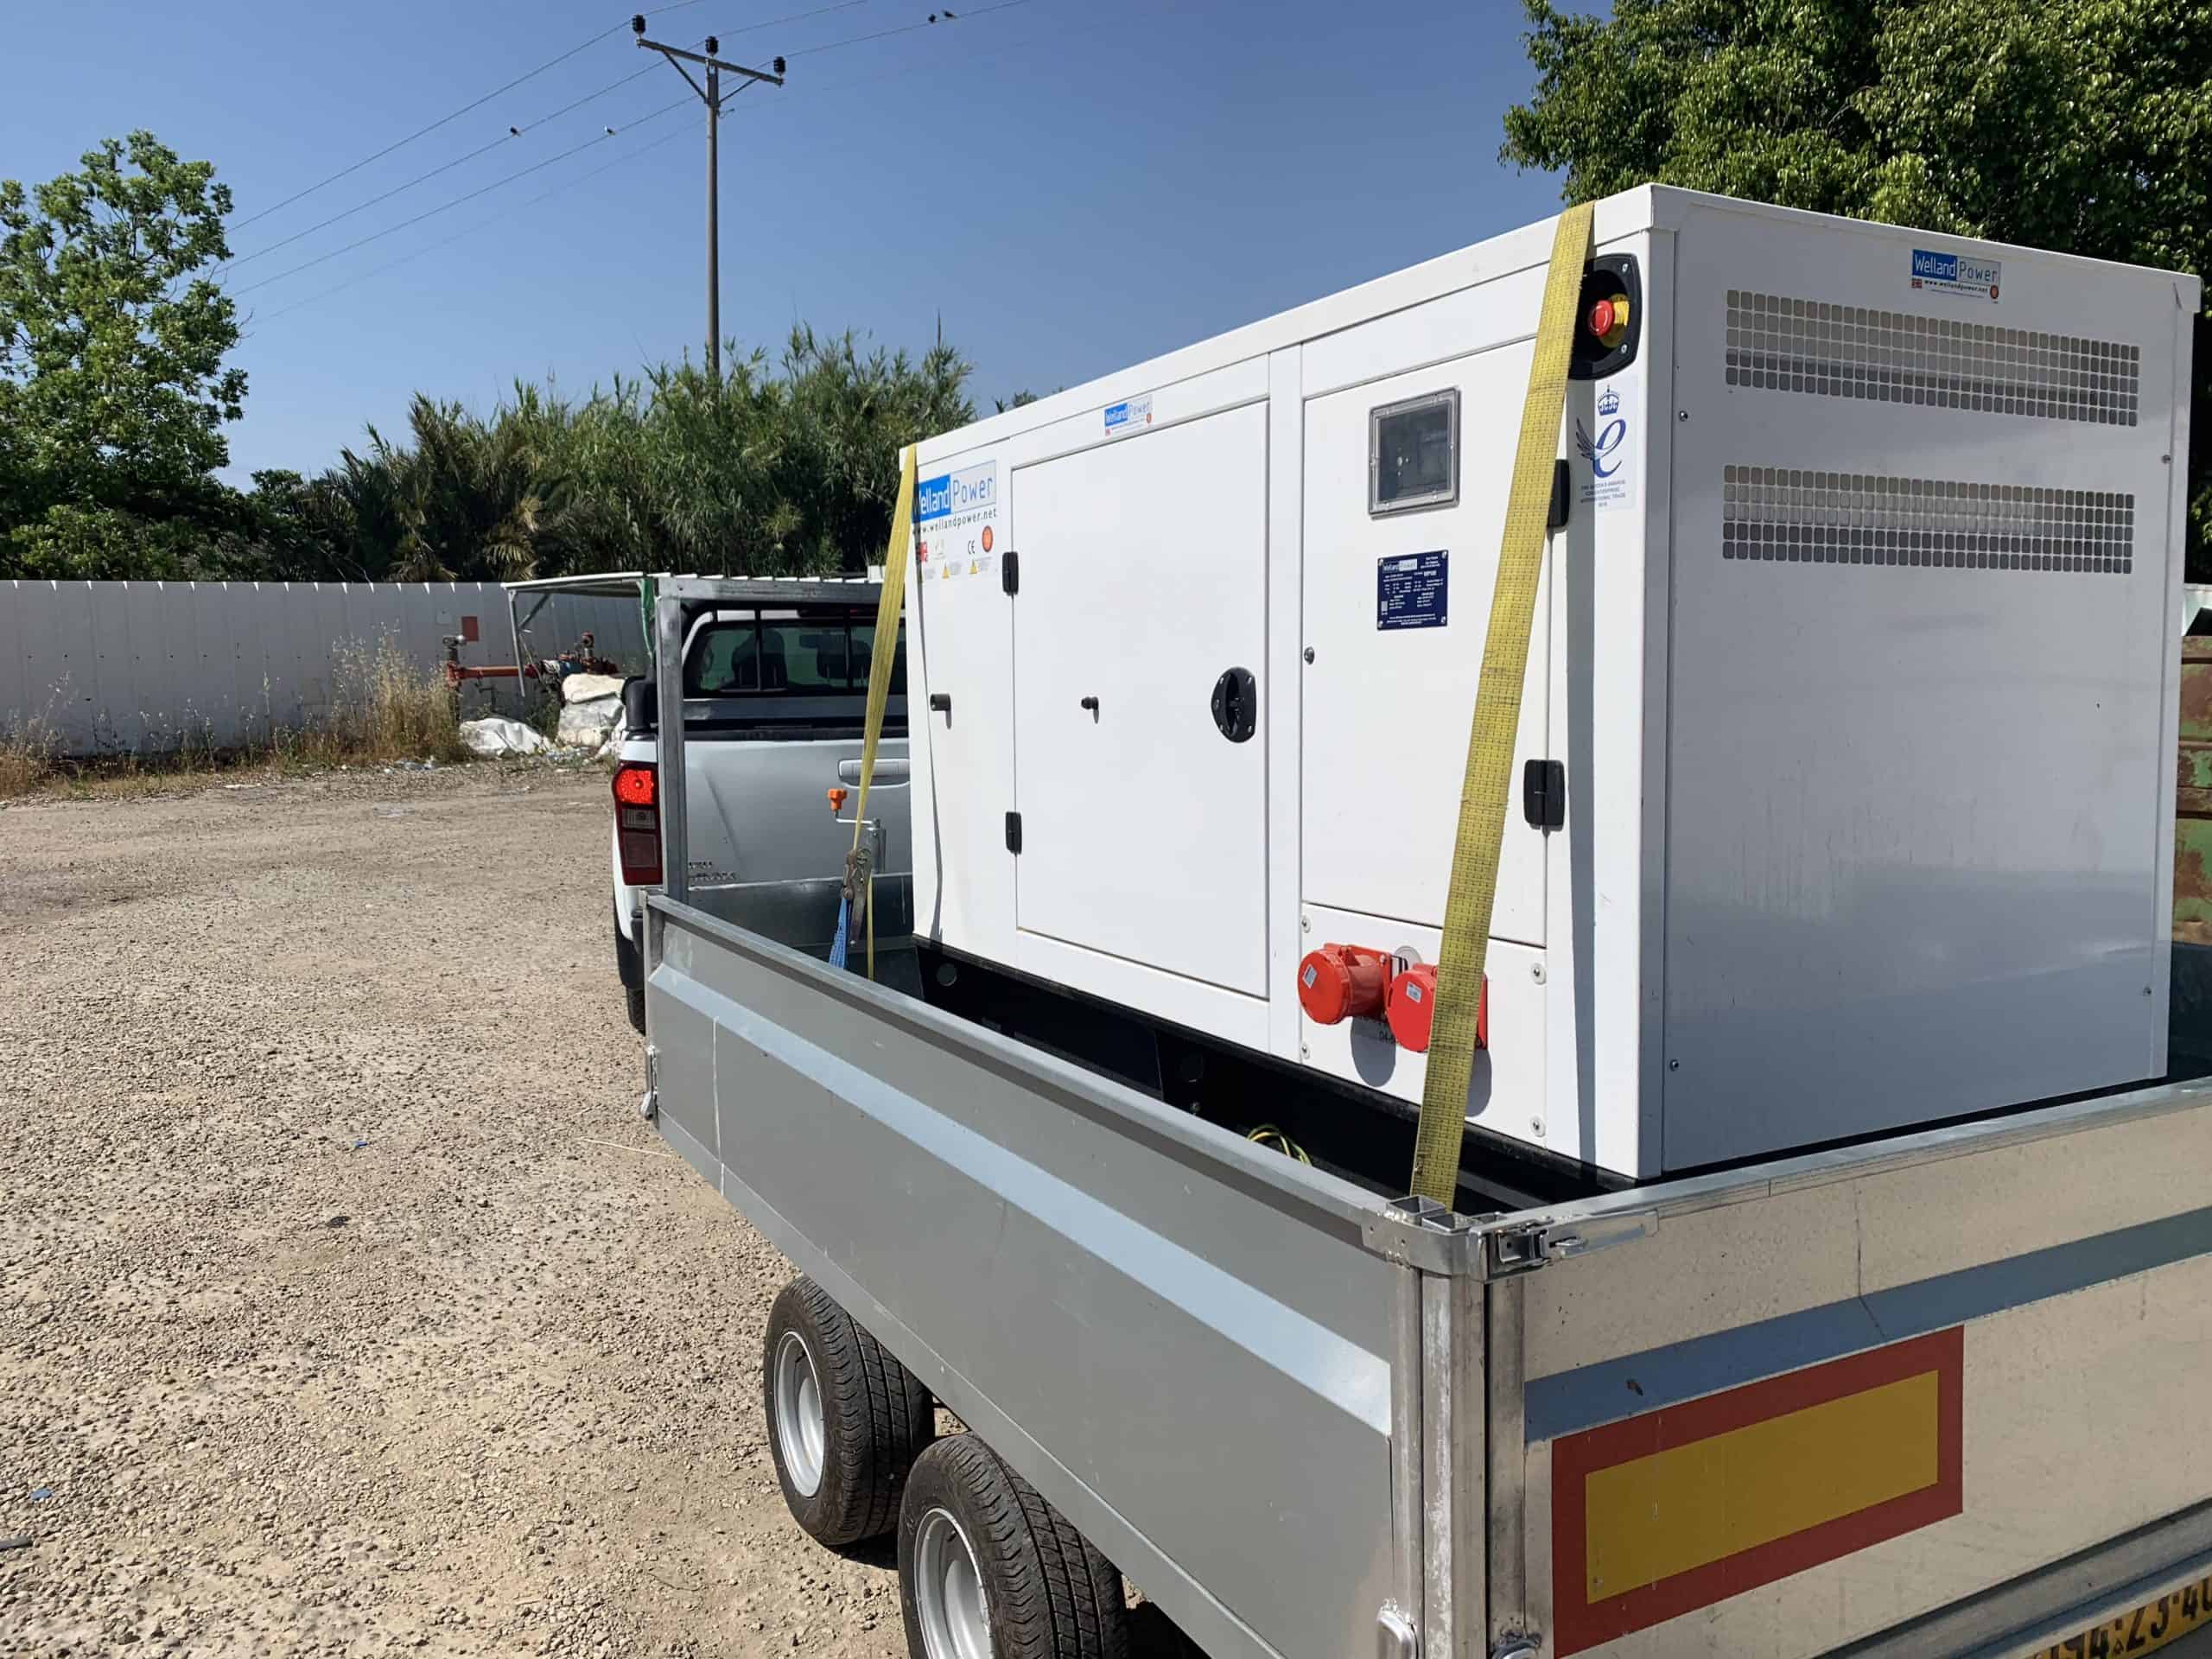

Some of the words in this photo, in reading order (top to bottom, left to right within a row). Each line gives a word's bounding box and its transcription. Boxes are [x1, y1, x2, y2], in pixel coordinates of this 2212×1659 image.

[1914, 253, 1956, 277] Welland
[1958, 261, 1998, 283] Power
[952, 477, 993, 506] Power
